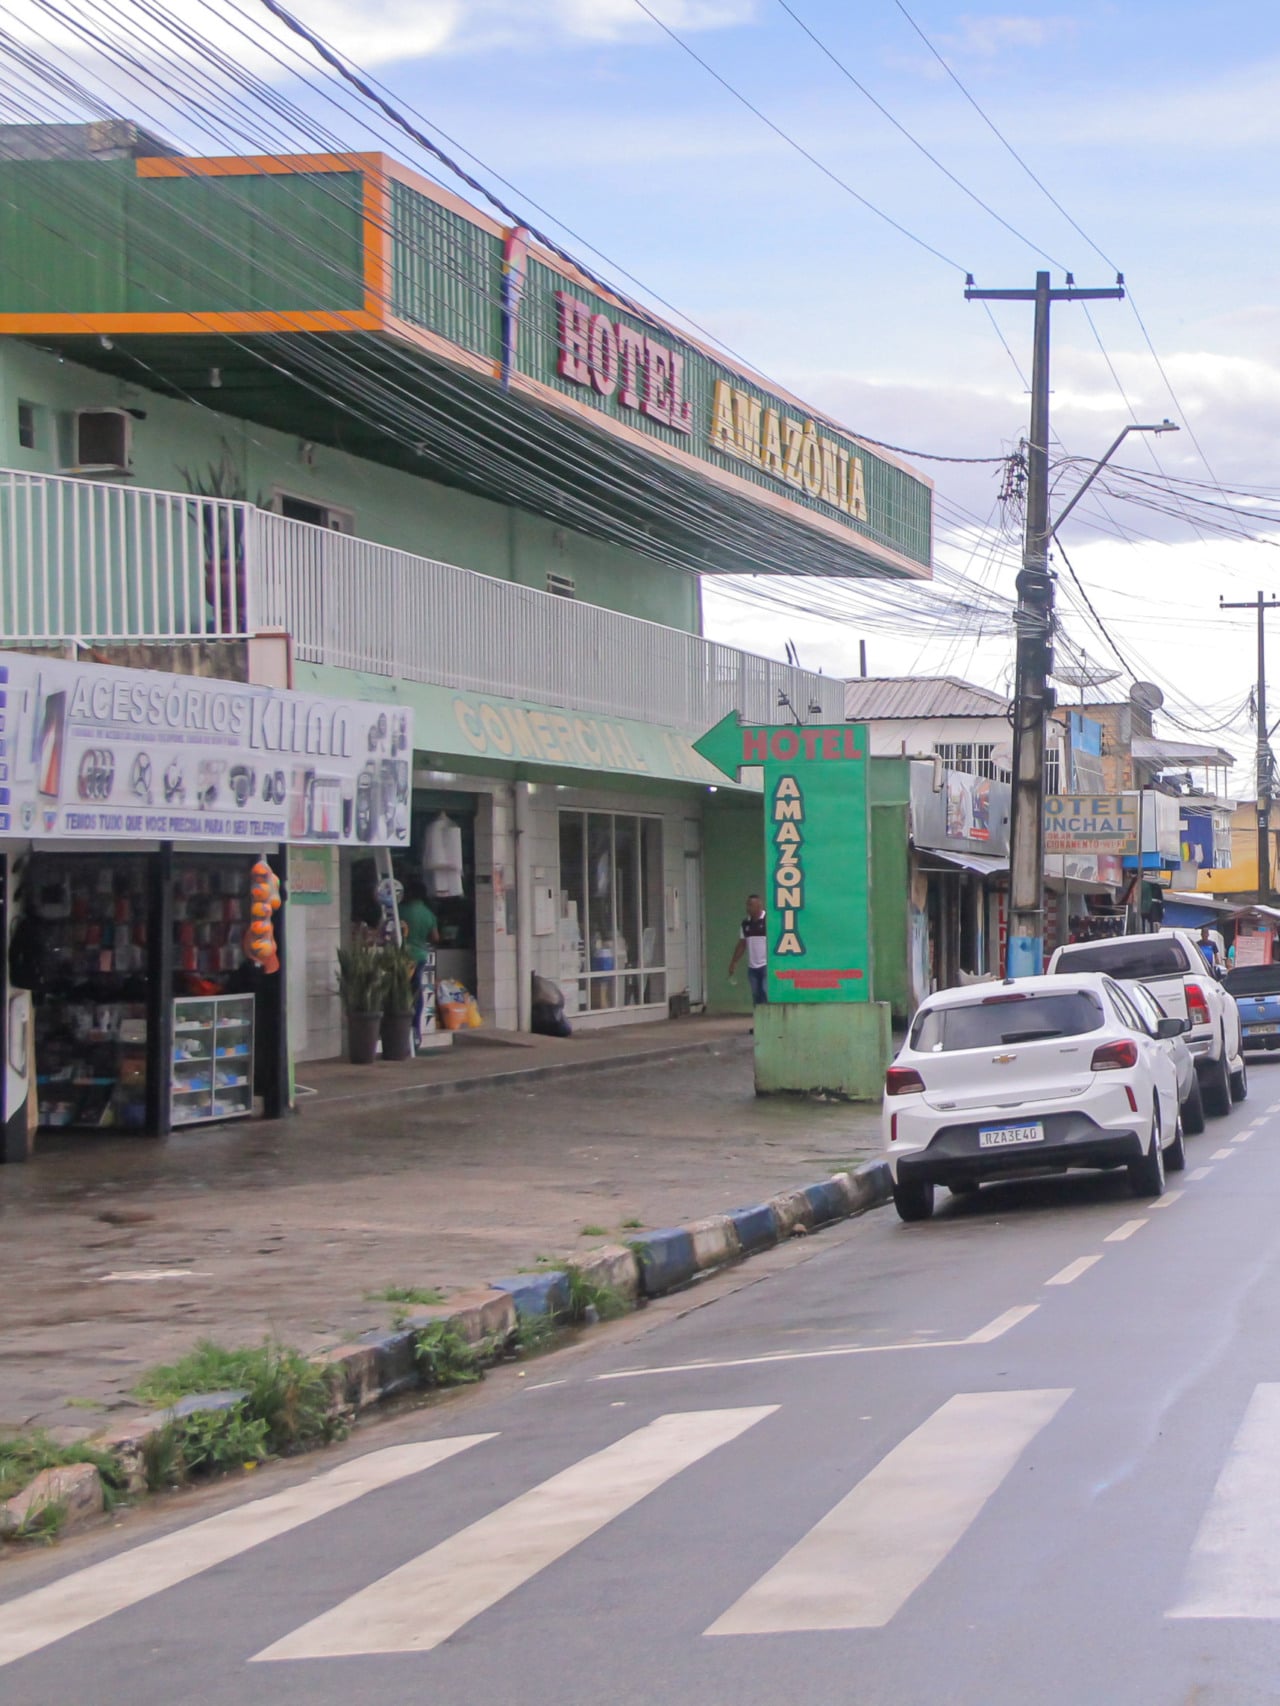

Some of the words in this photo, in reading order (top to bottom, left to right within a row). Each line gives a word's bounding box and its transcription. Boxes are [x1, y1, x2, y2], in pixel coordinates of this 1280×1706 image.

[556, 290, 691, 435] HOTEL
[709, 378, 868, 522] AMAZÔNIA
[69, 675, 244, 733] ACESSÓRIOS
[453, 698, 650, 771] COMERCIAL
[742, 729, 863, 761] HOTEL
[66, 812, 97, 831] TEMOS
[125, 815, 143, 832] QUE
[204, 818, 224, 834] PARA
[233, 819, 248, 835] SEU
[985, 1127, 1037, 1145] RZA3E40
